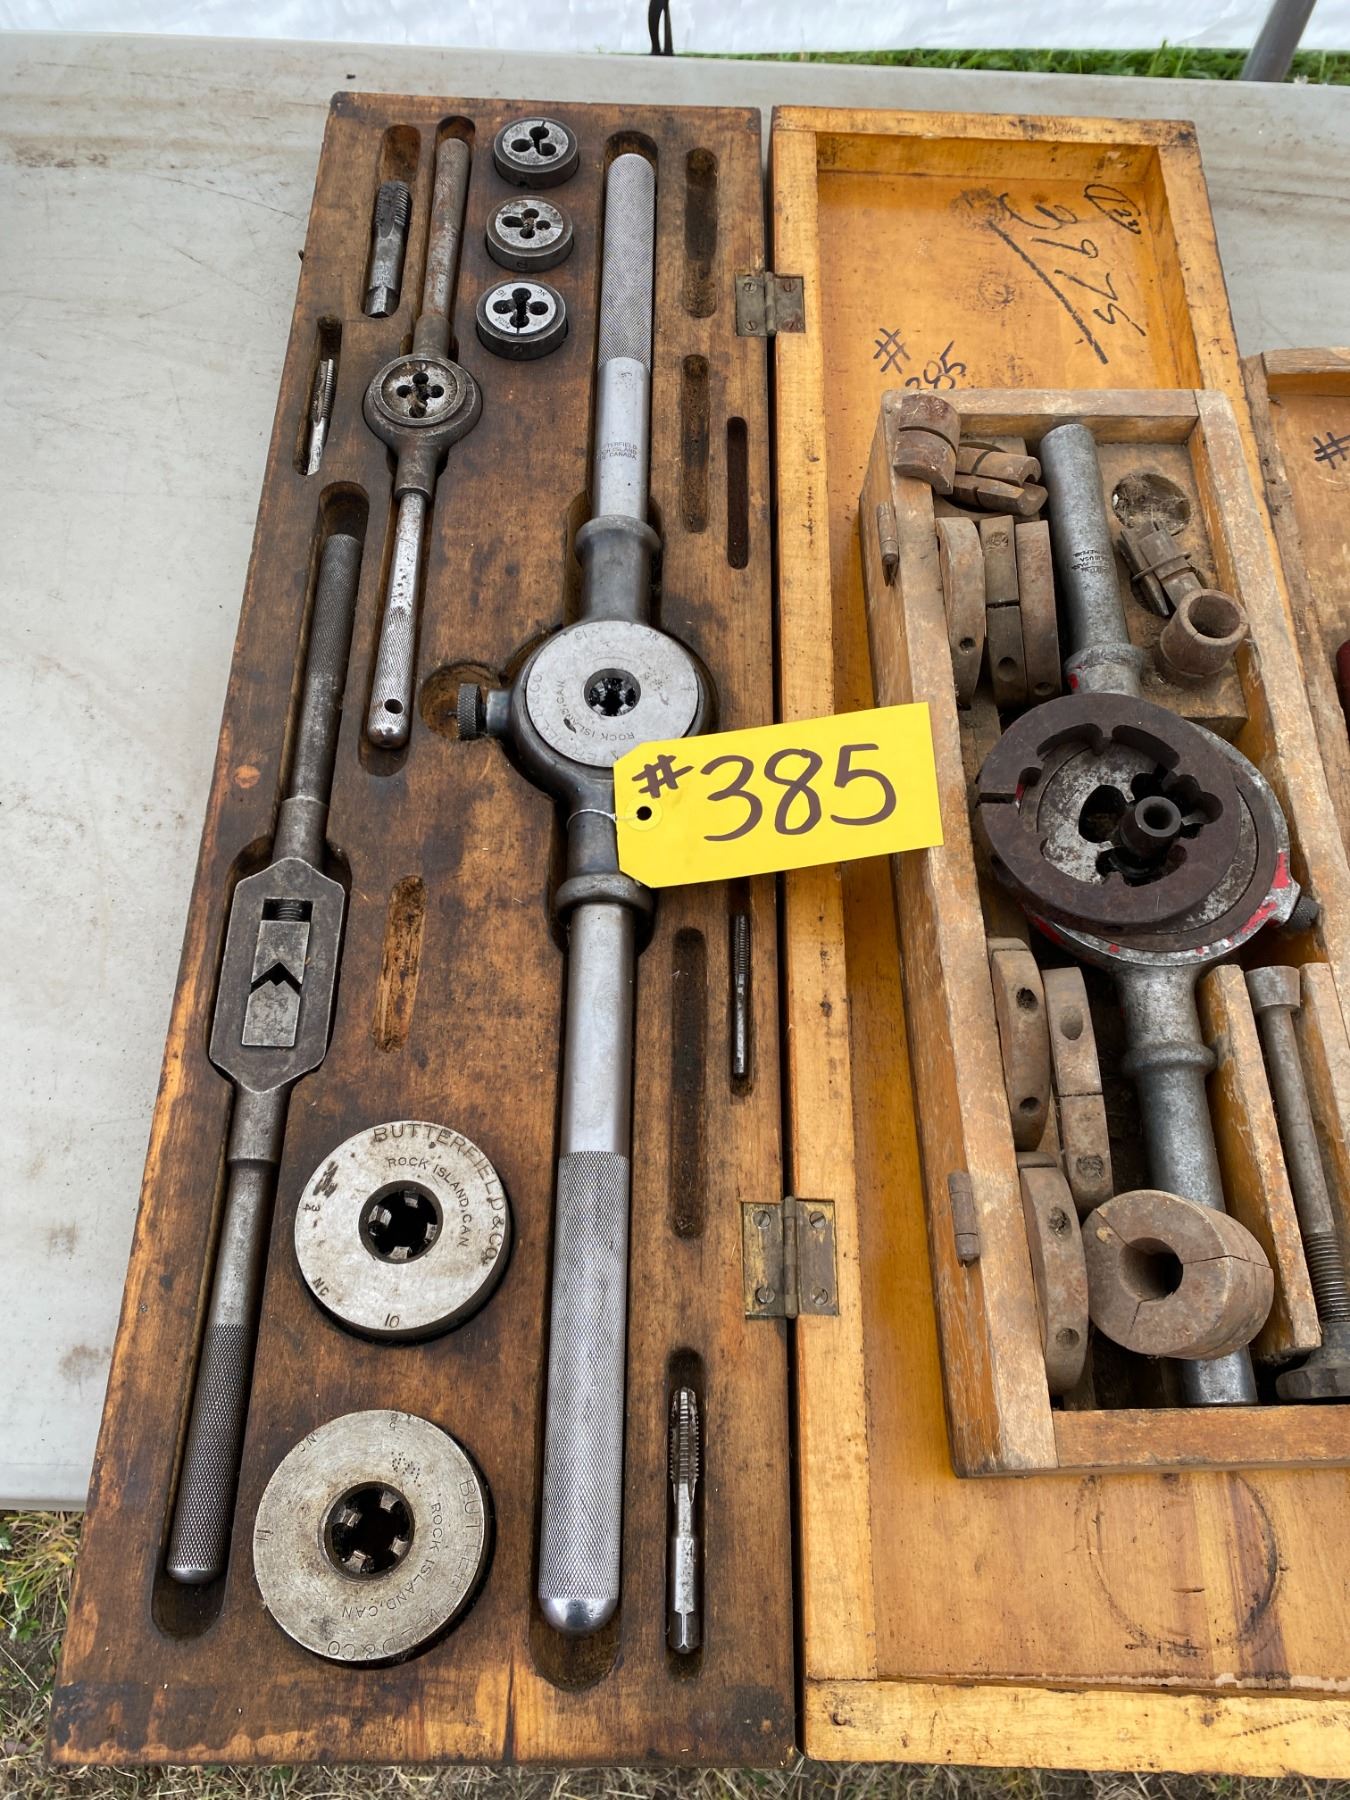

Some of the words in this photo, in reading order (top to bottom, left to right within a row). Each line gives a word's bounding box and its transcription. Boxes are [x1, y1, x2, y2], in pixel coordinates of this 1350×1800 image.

[873, 328, 911, 374] #
[602, 731, 635, 742] ROCK
[373, 1123, 504, 1211] BUTTERFIELD
[386, 1156, 428, 1170] ROCK
[312, 1277, 330, 1297] NC
[299, 1432, 317, 1453] NC
[430, 1502, 443, 1552] ROCK
